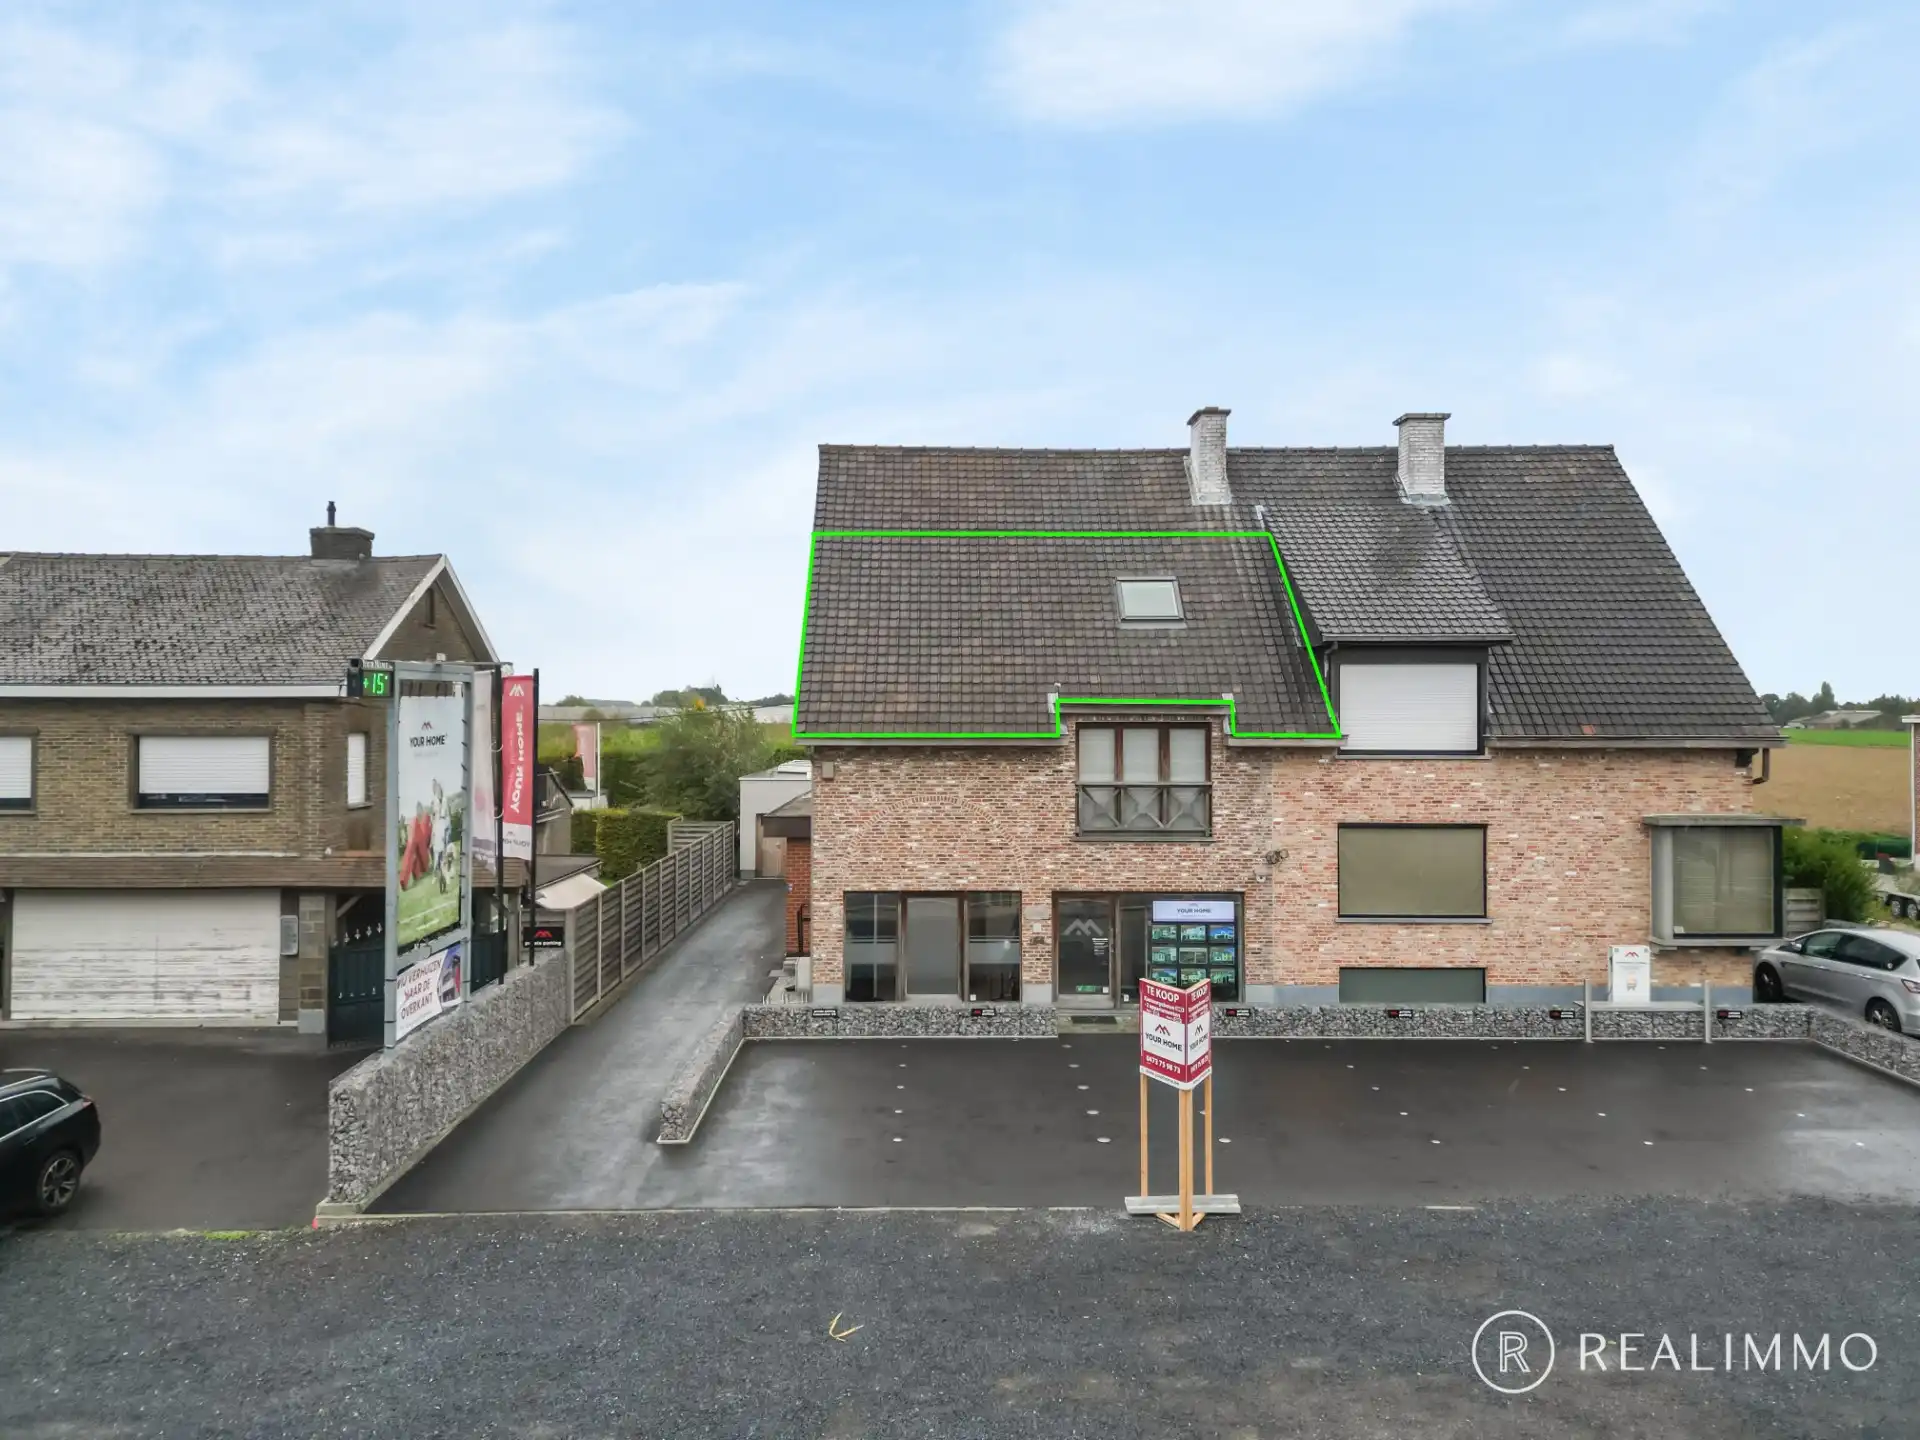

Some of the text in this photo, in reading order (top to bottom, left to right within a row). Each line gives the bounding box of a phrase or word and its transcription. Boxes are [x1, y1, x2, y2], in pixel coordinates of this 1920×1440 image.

[409, 735, 445, 747] YOUR HOME
[1146, 985, 1180, 1003] TE KOOP
[401, 993, 433, 1020] OVERKANT
[1145, 1032, 1162, 1044] YOUR
[1163, 1040, 1183, 1052] HOME
